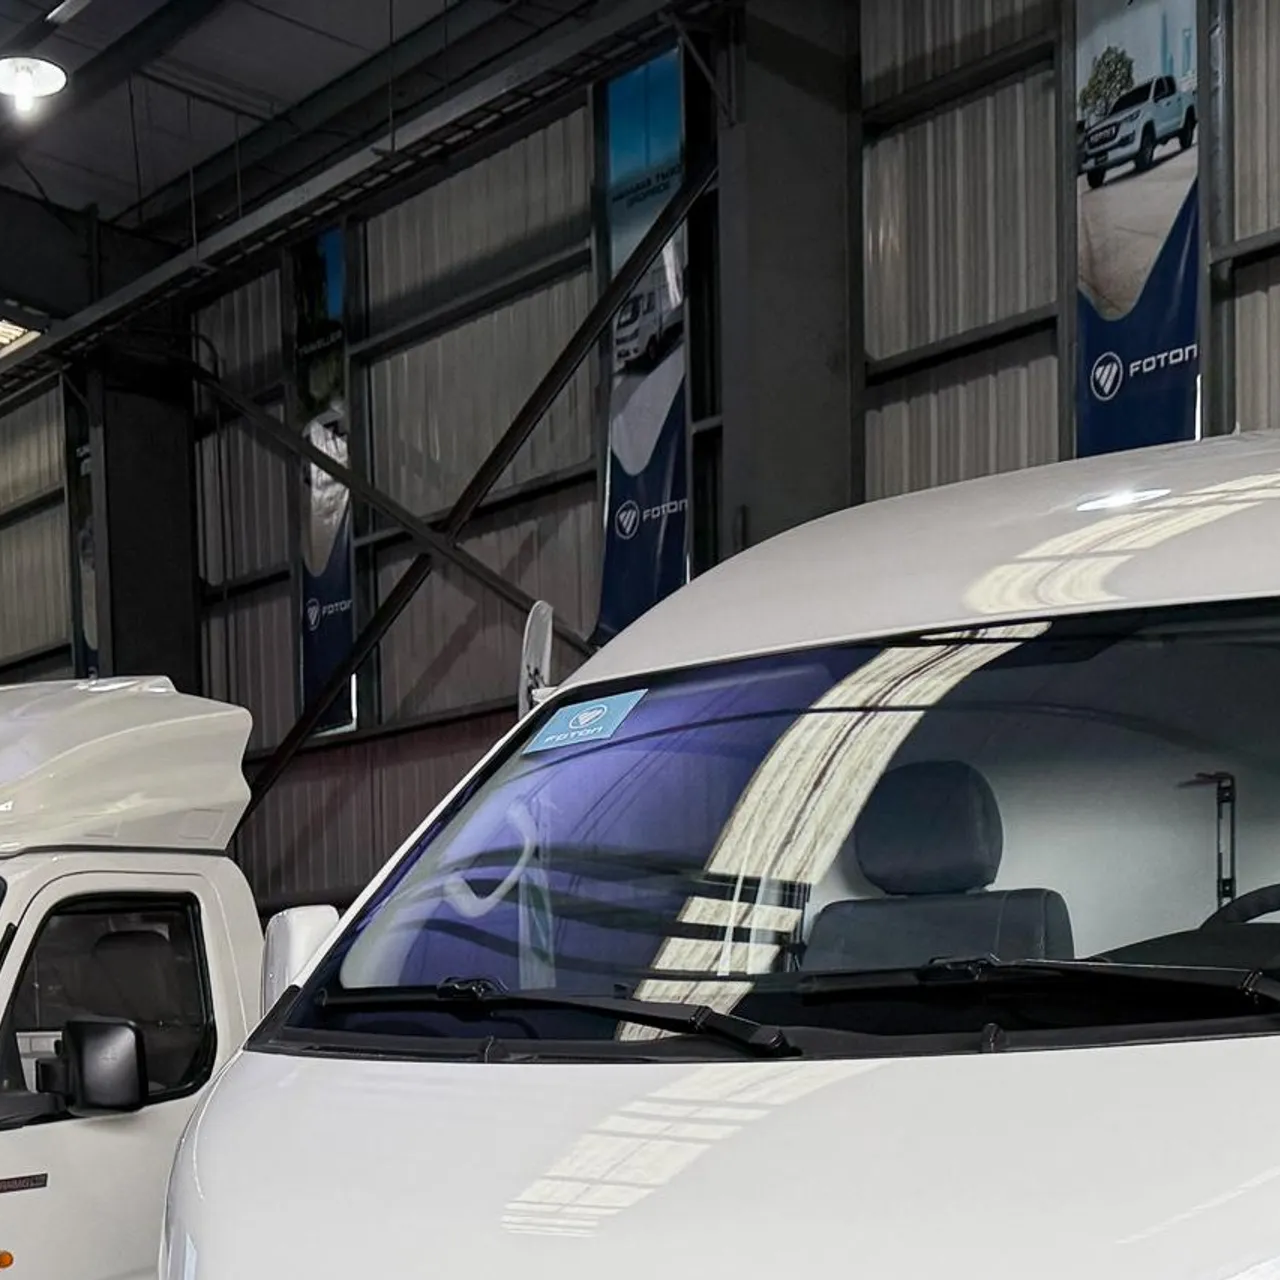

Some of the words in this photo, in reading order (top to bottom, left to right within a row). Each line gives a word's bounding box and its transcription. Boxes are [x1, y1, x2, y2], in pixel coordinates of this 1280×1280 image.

[1128, 343, 1198, 377] FOTON
[642, 499, 688, 521] FOTON
[544, 726, 603, 742] FOTON
